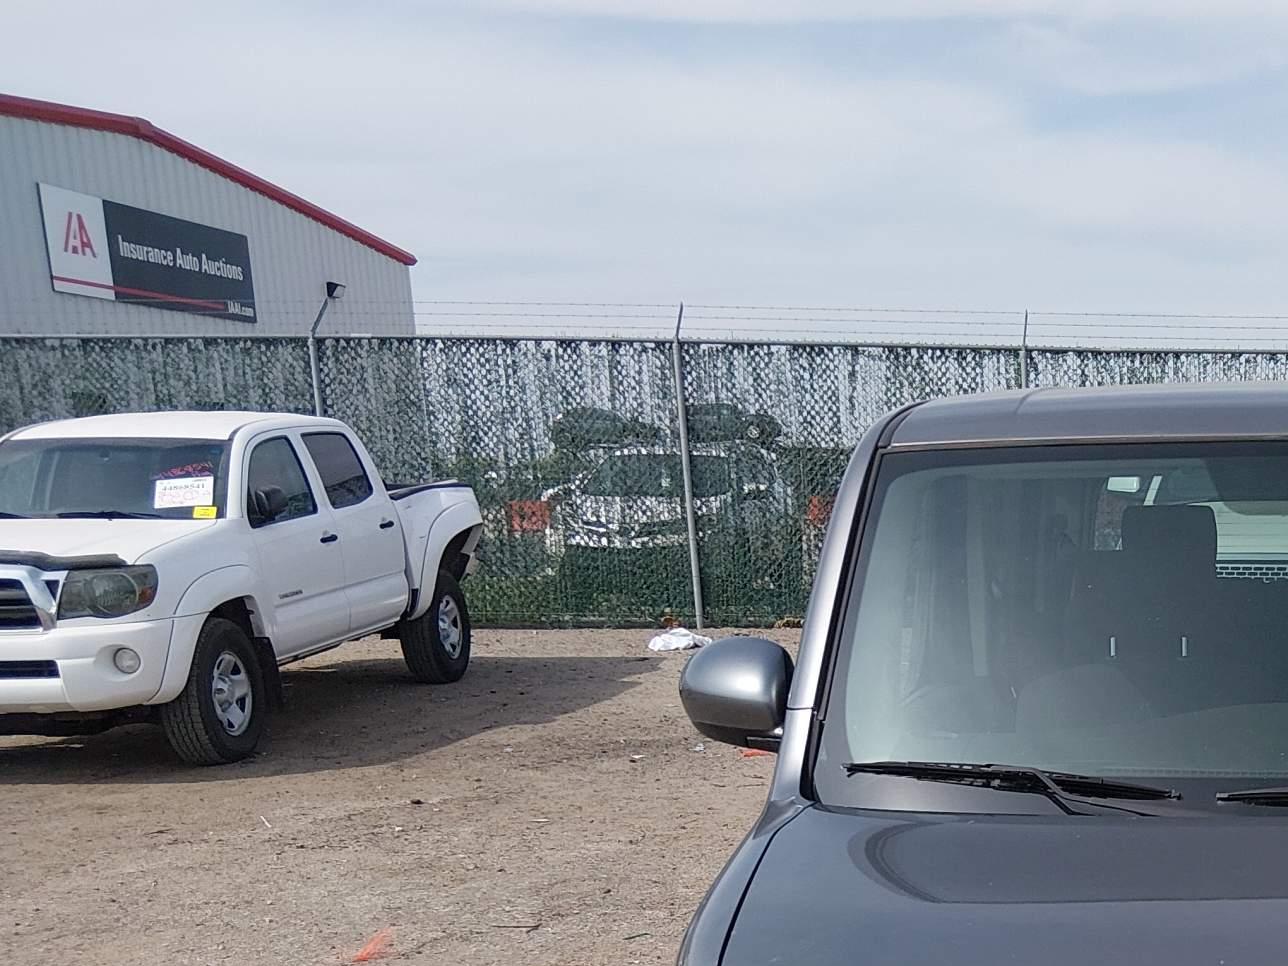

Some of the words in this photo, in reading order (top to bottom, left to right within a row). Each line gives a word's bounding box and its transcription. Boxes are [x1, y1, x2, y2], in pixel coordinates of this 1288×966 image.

[118, 234, 174, 267] Insurance
[176, 248, 199, 272] Auto
[201, 253, 244, 280] Auctions
[227, 300, 254, 317] IAAI.com
